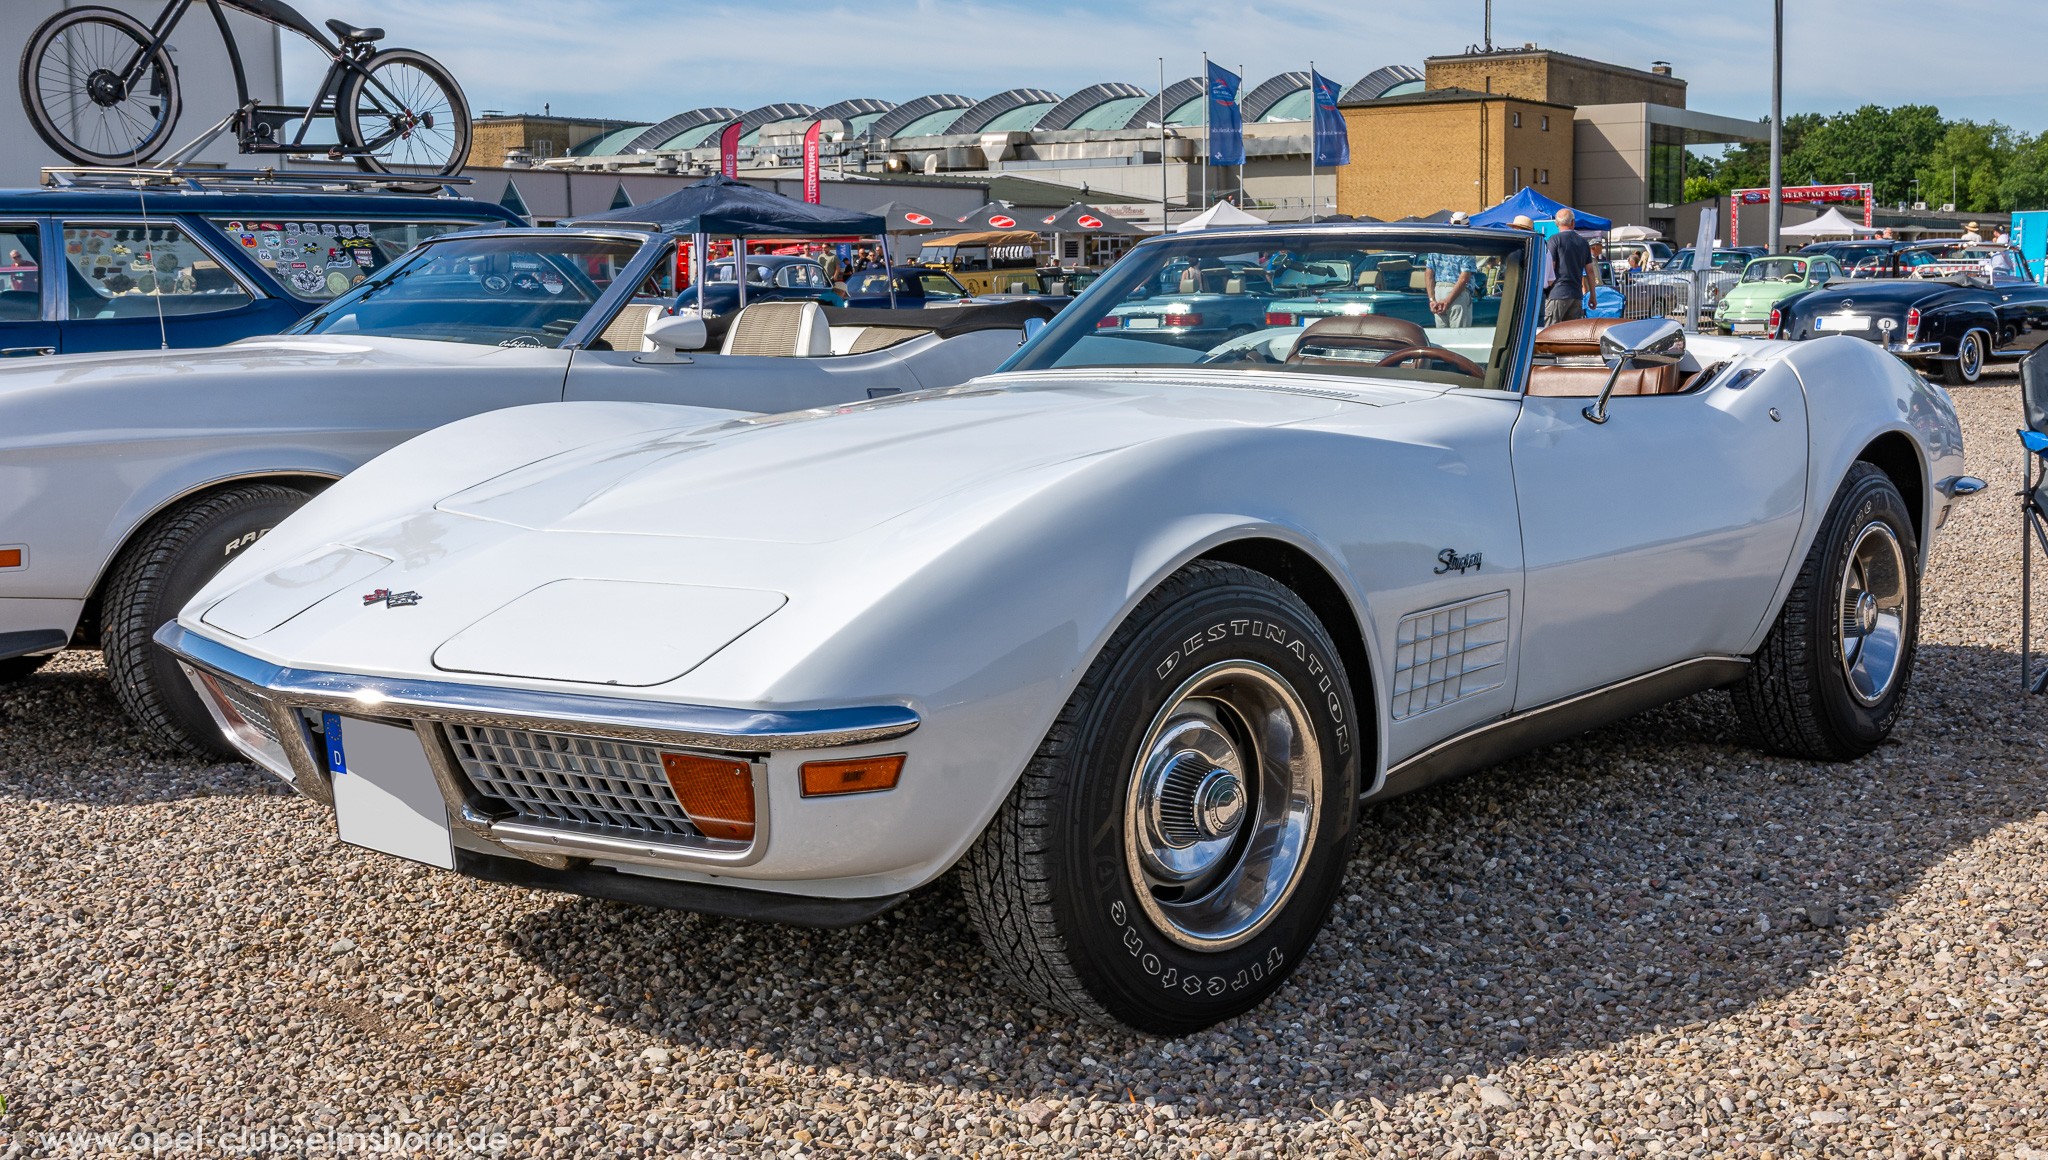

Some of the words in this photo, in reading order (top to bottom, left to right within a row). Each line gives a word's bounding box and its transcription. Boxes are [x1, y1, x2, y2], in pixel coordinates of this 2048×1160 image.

[807, 139, 816, 204] CURRYWURST
[1884, 320, 1890, 329] D
[1157, 619, 1349, 755] DESTINATION
[333, 749, 343, 766] D
[1110, 900, 1284, 996] Firestone
